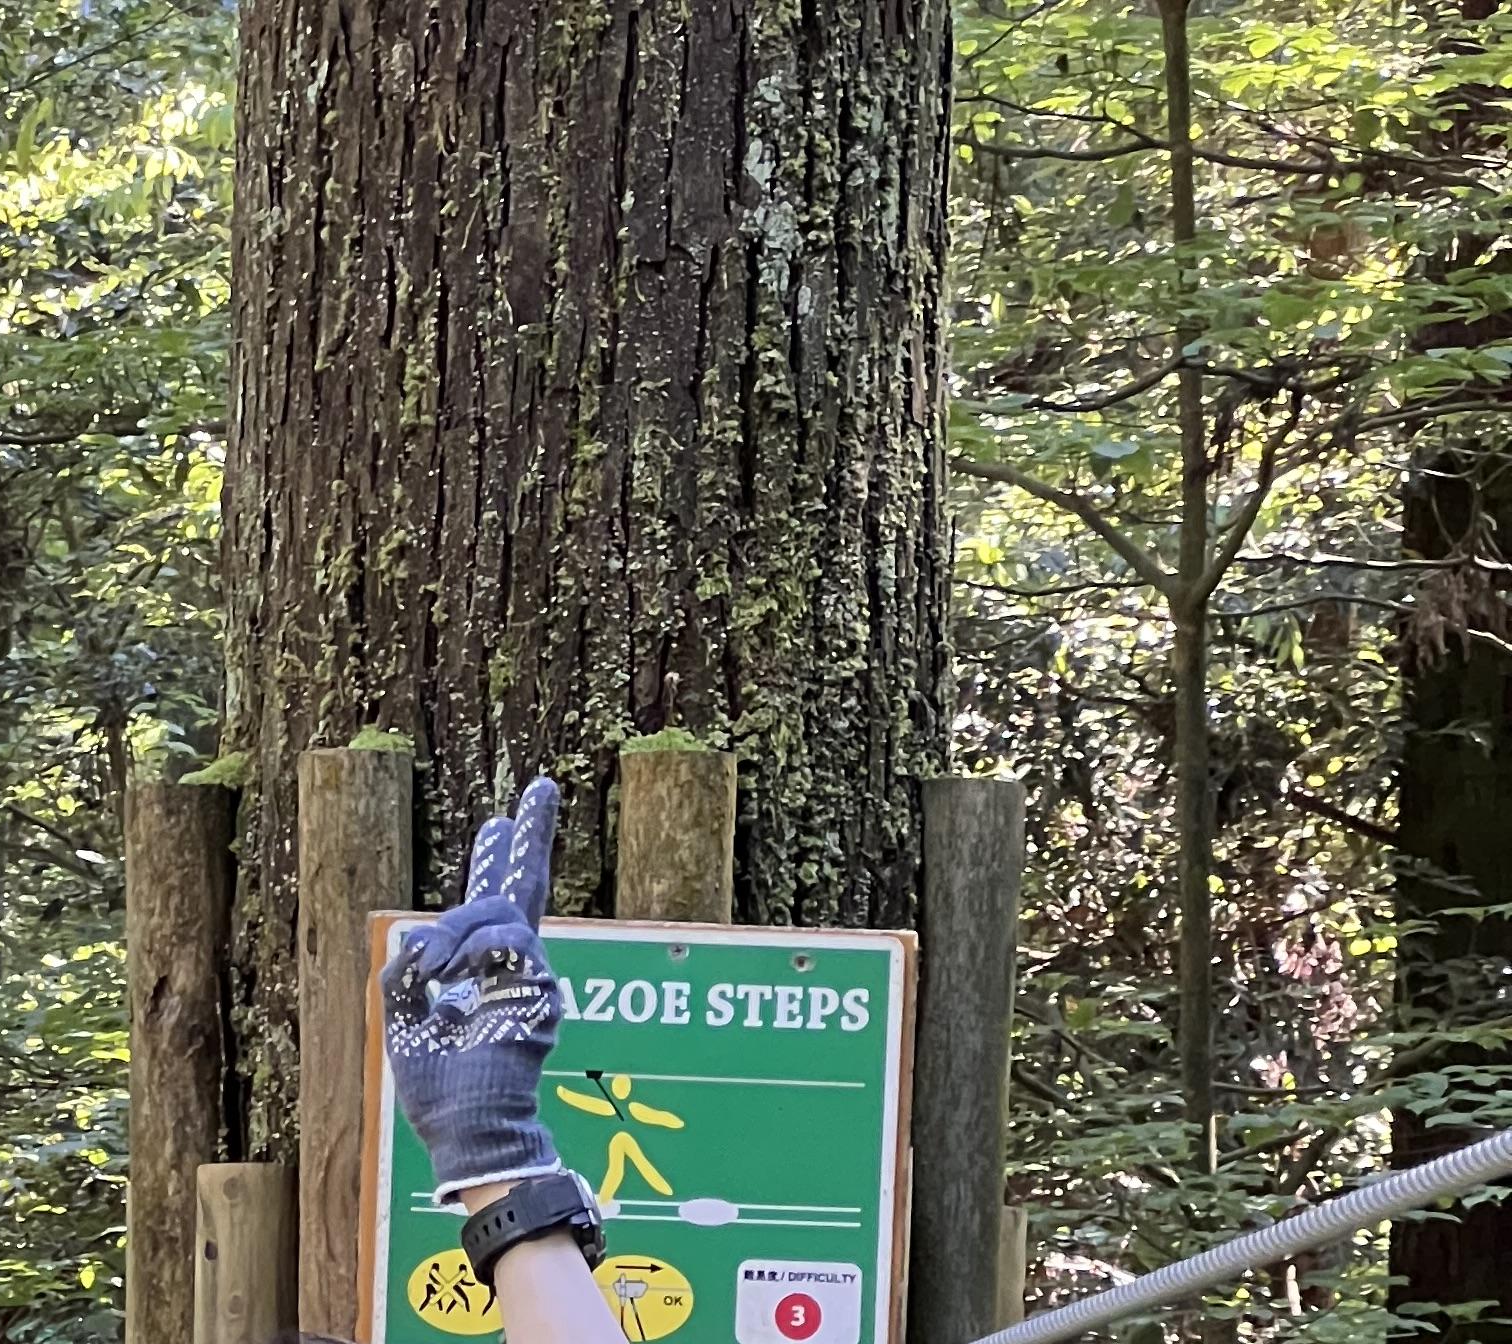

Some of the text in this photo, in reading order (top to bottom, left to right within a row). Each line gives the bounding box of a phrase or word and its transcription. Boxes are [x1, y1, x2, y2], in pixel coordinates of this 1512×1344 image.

[558, 976, 691, 1024] AZOE
[705, 982, 870, 1032] STEPS
[788, 1271, 856, 1284] DIFFICULTY
[663, 1295, 683, 1306] OK
[790, 1305, 806, 1327] 3
